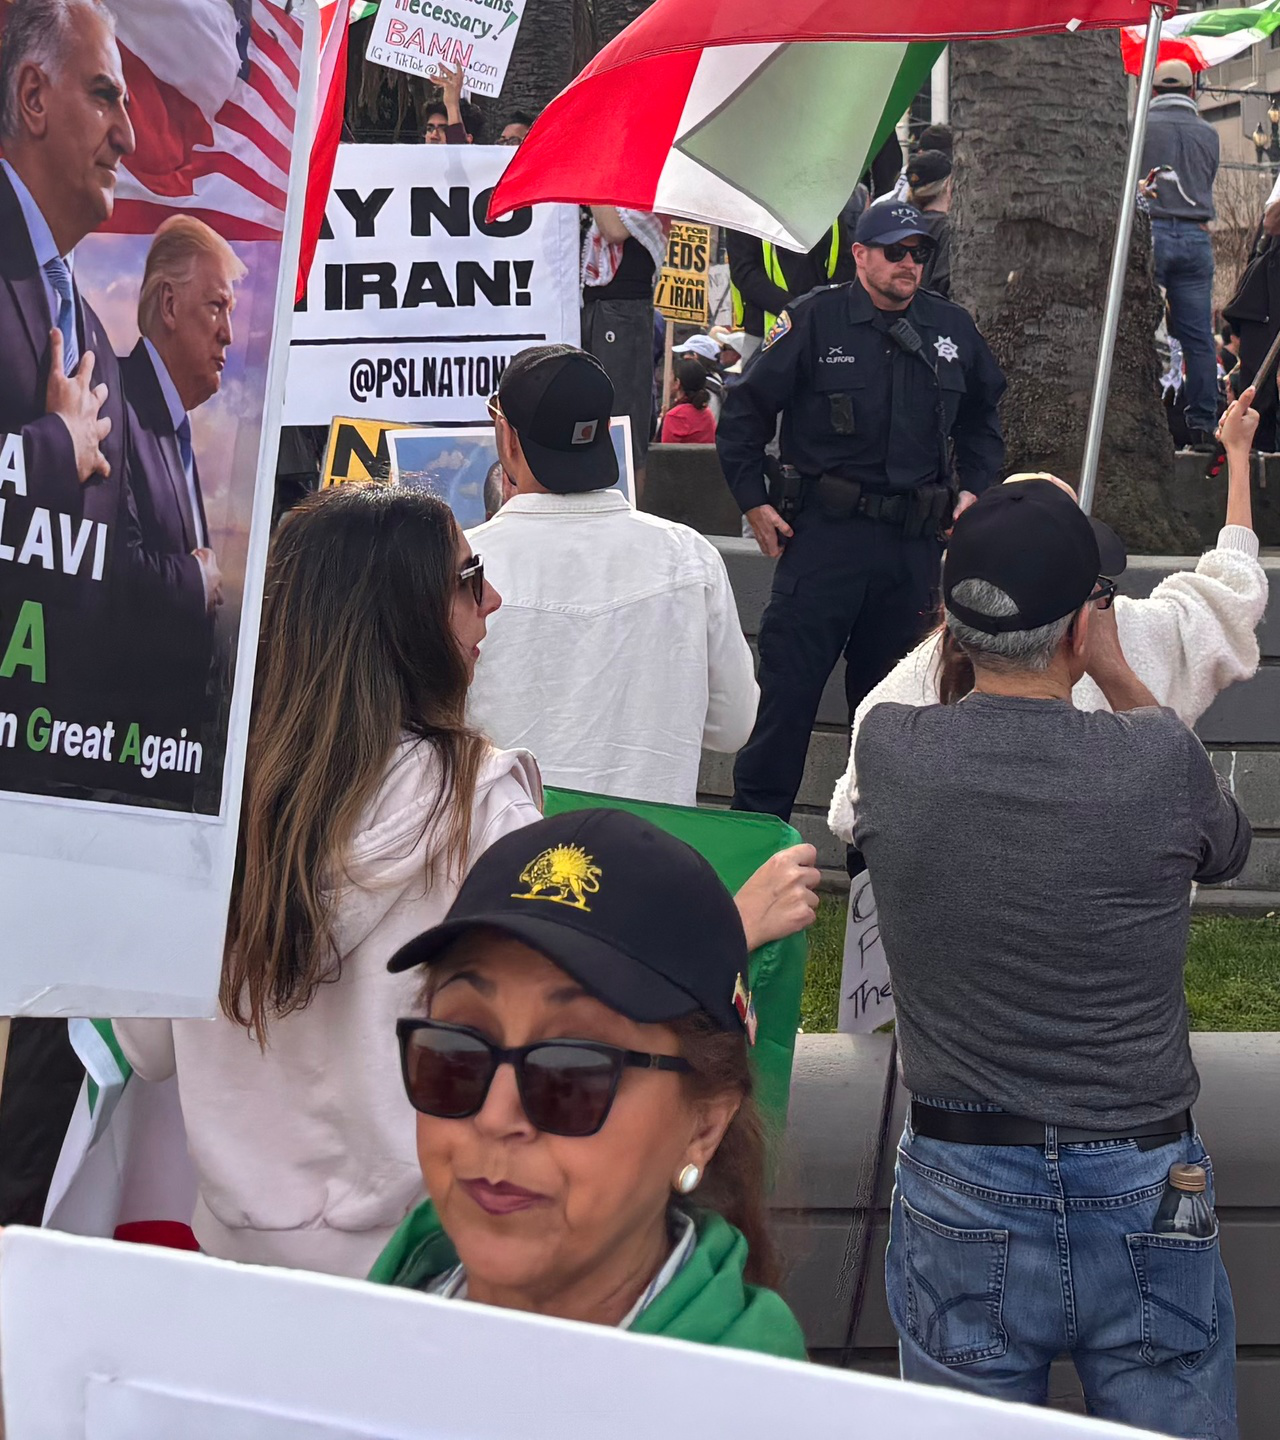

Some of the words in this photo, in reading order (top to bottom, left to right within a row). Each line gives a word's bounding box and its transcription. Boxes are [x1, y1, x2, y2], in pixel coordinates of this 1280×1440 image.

[325, 260, 534, 310] IRAN!
[670, 285, 704, 310] IRAN
[673, 277, 705, 288] WAR
[26, 707, 115, 762] Great
[118, 722, 203, 779] Again
